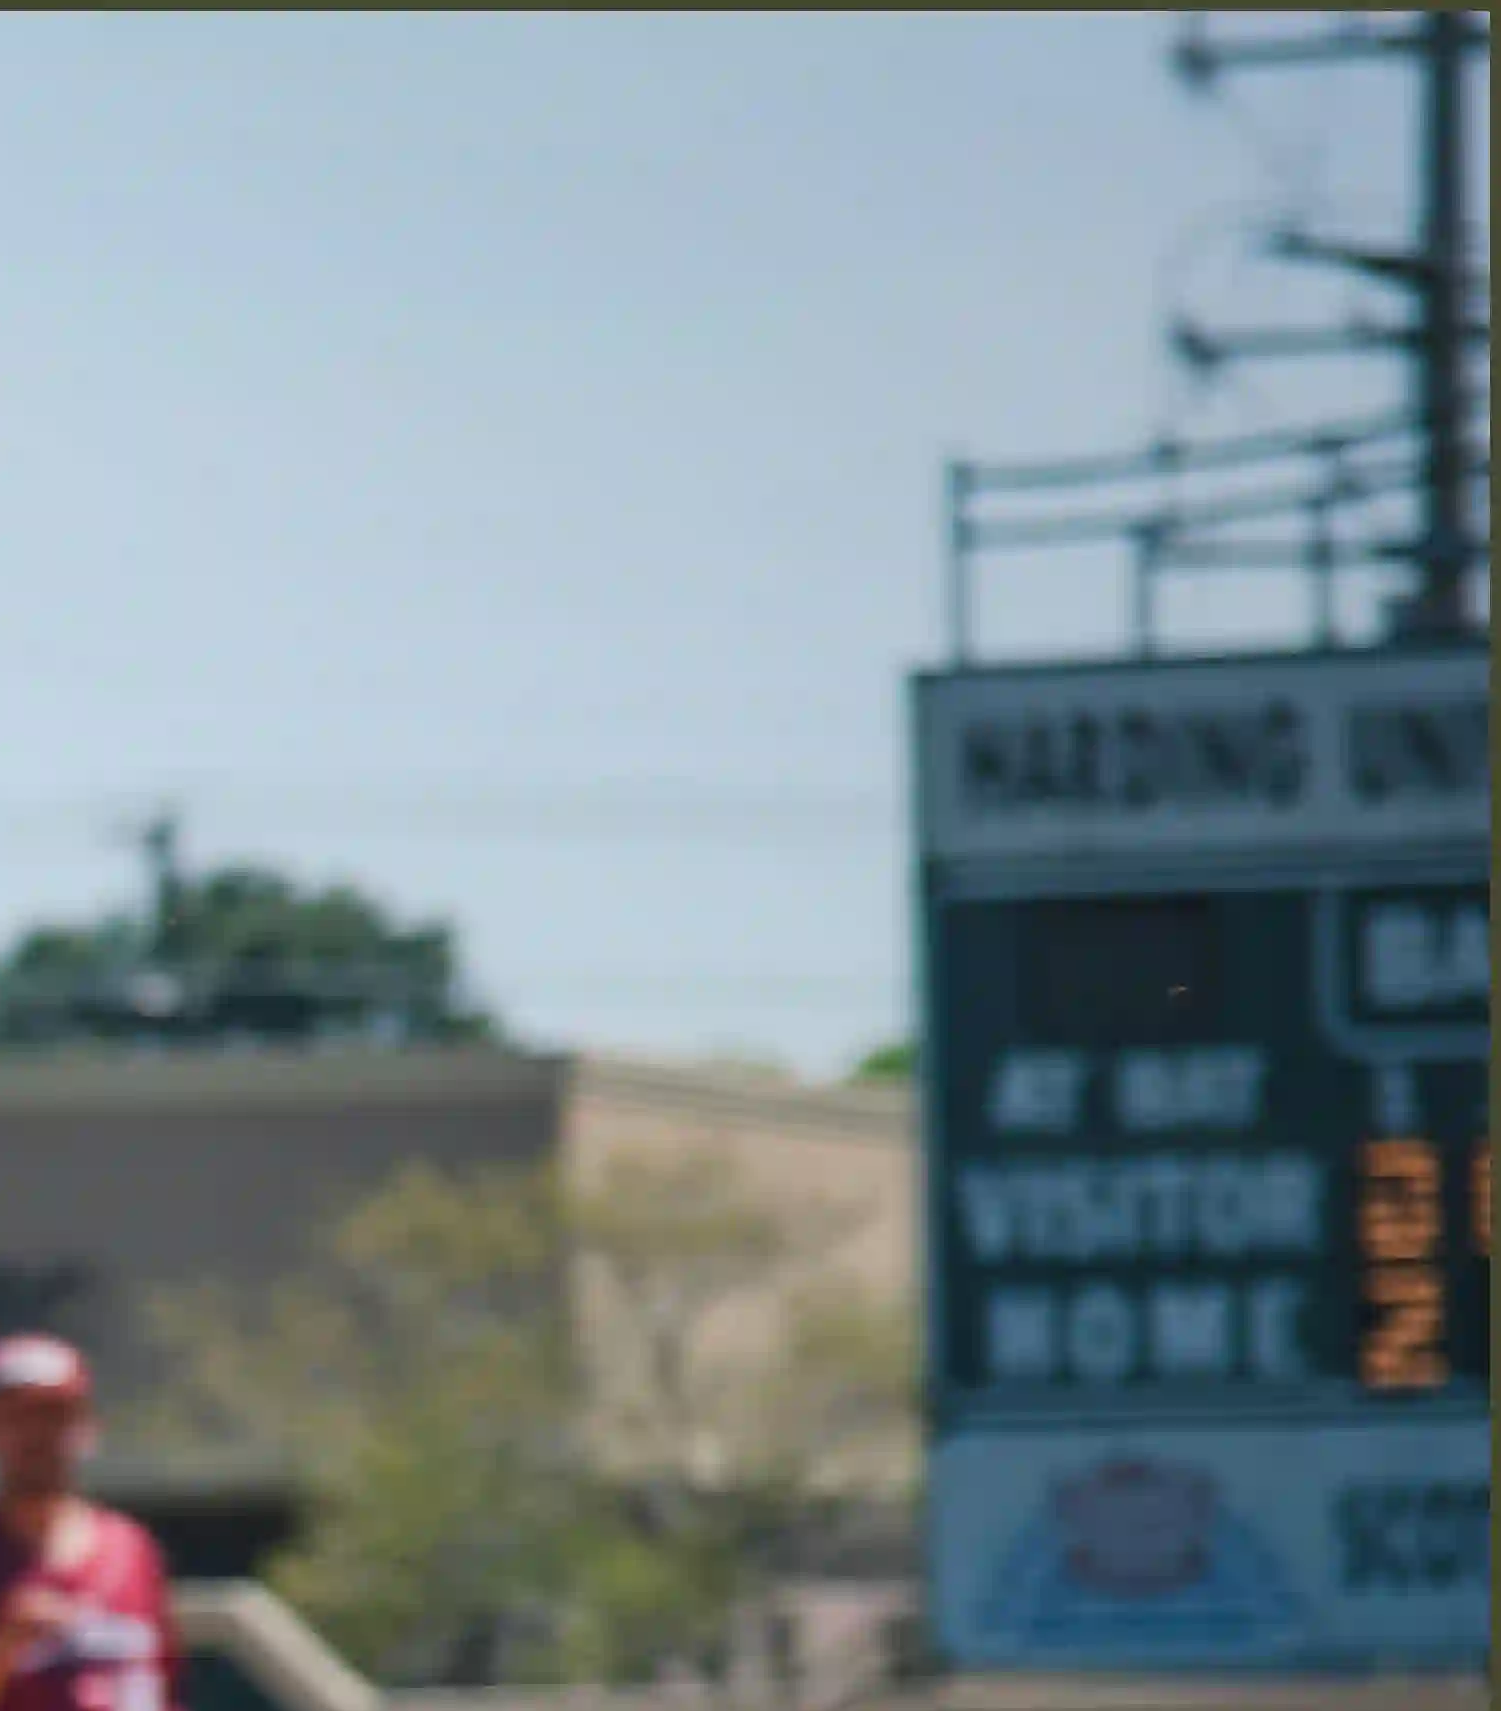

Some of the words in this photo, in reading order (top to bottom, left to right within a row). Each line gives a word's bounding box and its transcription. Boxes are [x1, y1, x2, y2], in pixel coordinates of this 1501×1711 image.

[958, 697, 1308, 812] HARDING
[958, 1148, 1320, 1264] VISITOR
[988, 1278, 1302, 1380] HOME
